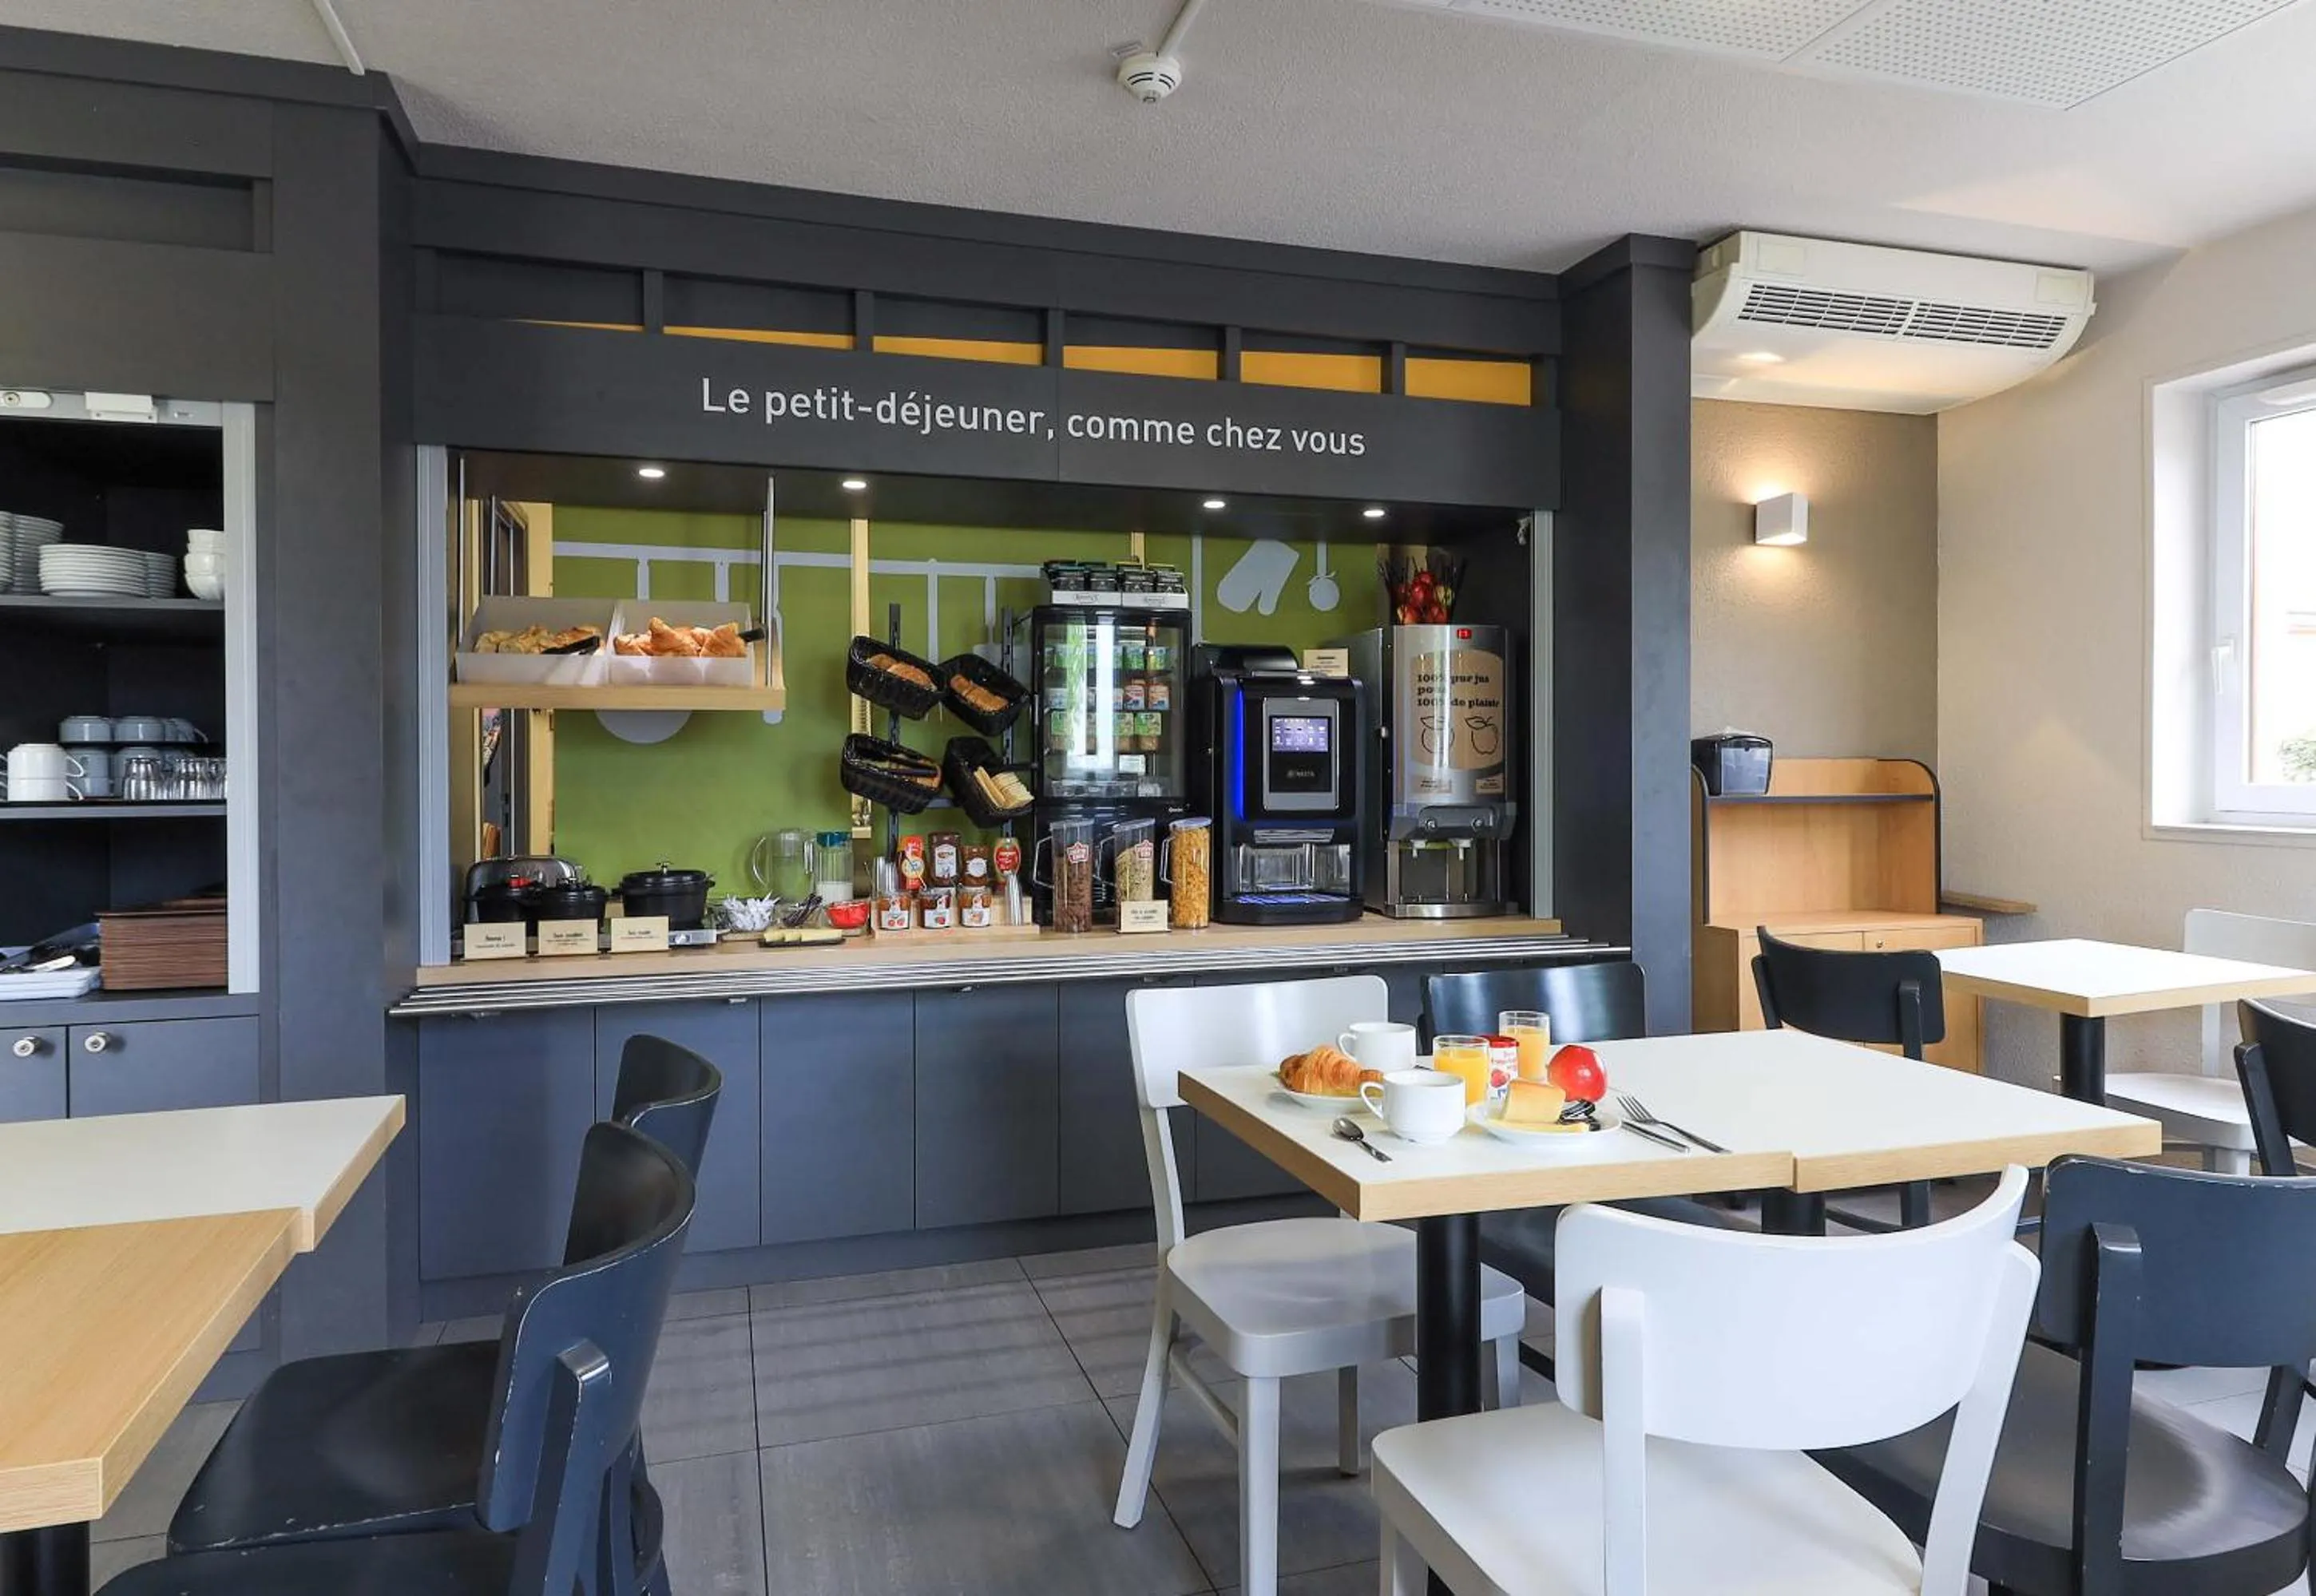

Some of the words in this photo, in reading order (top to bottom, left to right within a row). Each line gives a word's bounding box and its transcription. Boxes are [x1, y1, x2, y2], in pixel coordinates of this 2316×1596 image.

[702, 377, 750, 414] Le
[764, 386, 1055, 441] petit-déjeuner,
[1067, 413, 1195, 445] comme
[1206, 417, 1282, 451] chez
[1291, 429, 1366, 456] vous
[1474, 674, 1489, 684] jus
[1468, 699, 1499, 708] plaisir
